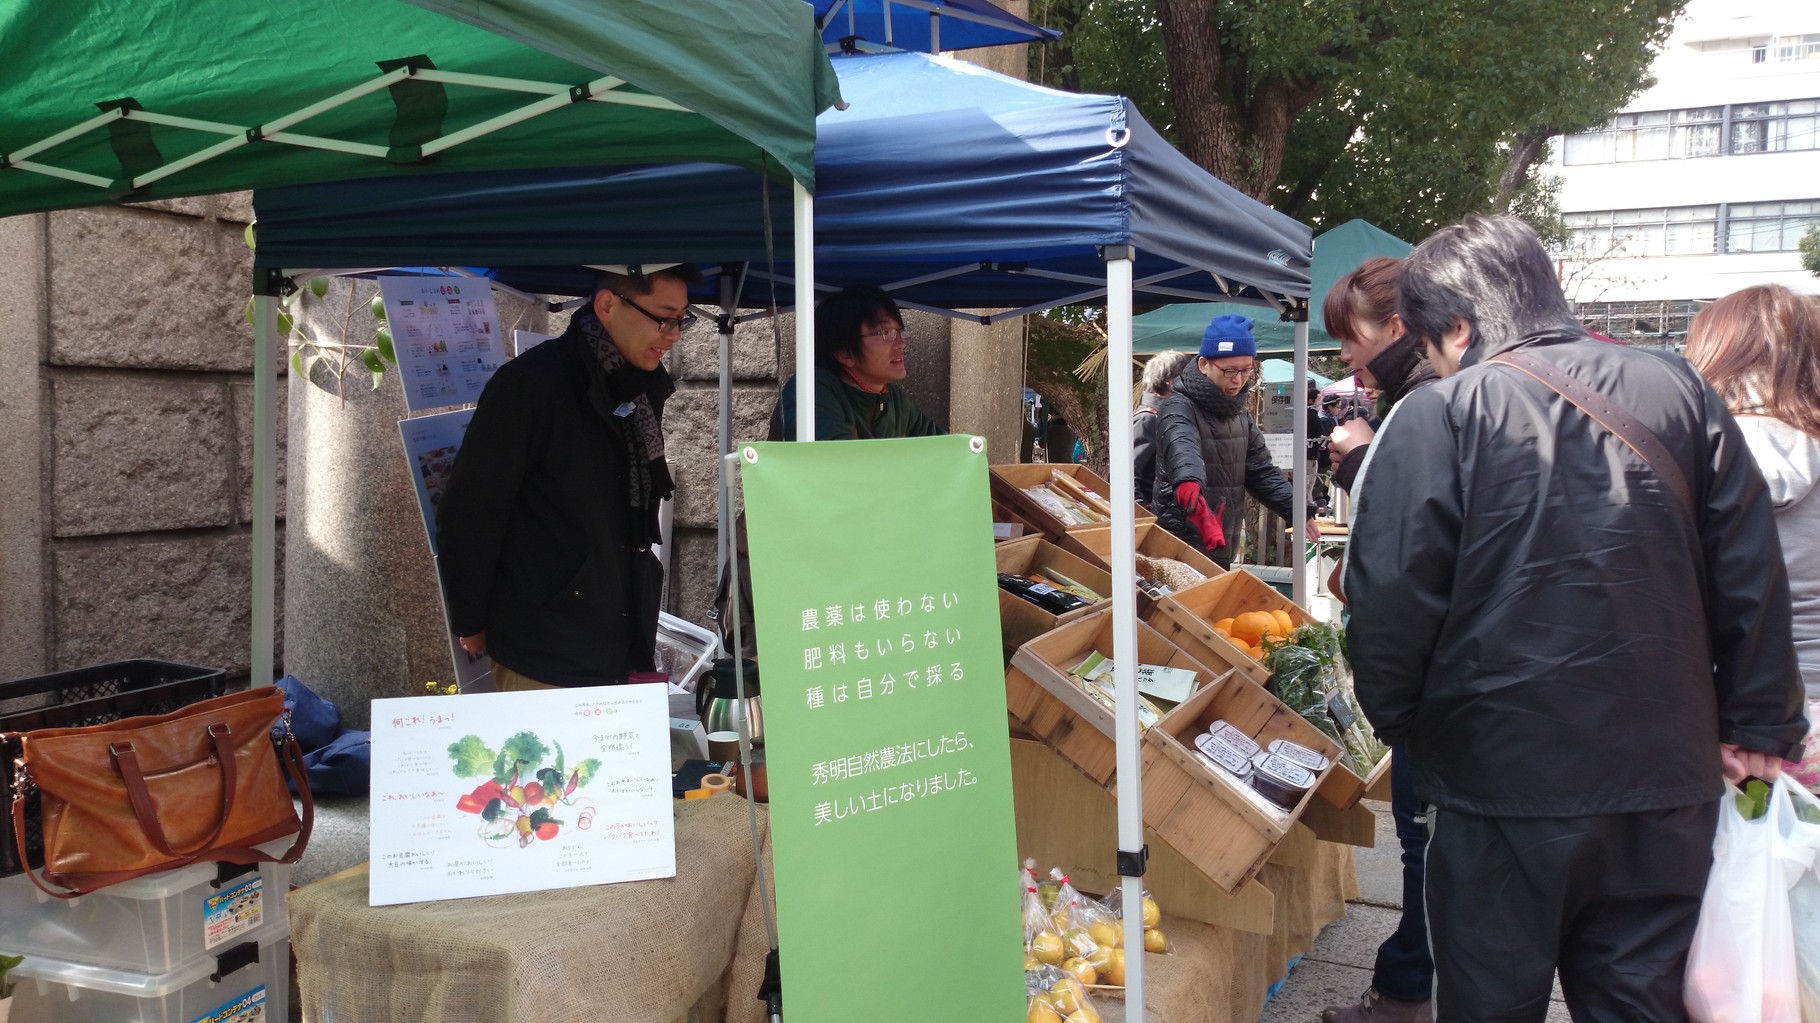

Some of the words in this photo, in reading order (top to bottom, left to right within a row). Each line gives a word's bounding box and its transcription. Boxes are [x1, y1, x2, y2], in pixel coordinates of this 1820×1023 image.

[801, 592, 958, 631] 農薬は使わない
[804, 629, 961, 670] 肥料もいらない
[806, 662, 964, 709] 種は自分で採る
[812, 732, 974, 786] 秀明自然農法にしたら、
[815, 768, 978, 826] 美しい土になりました。
